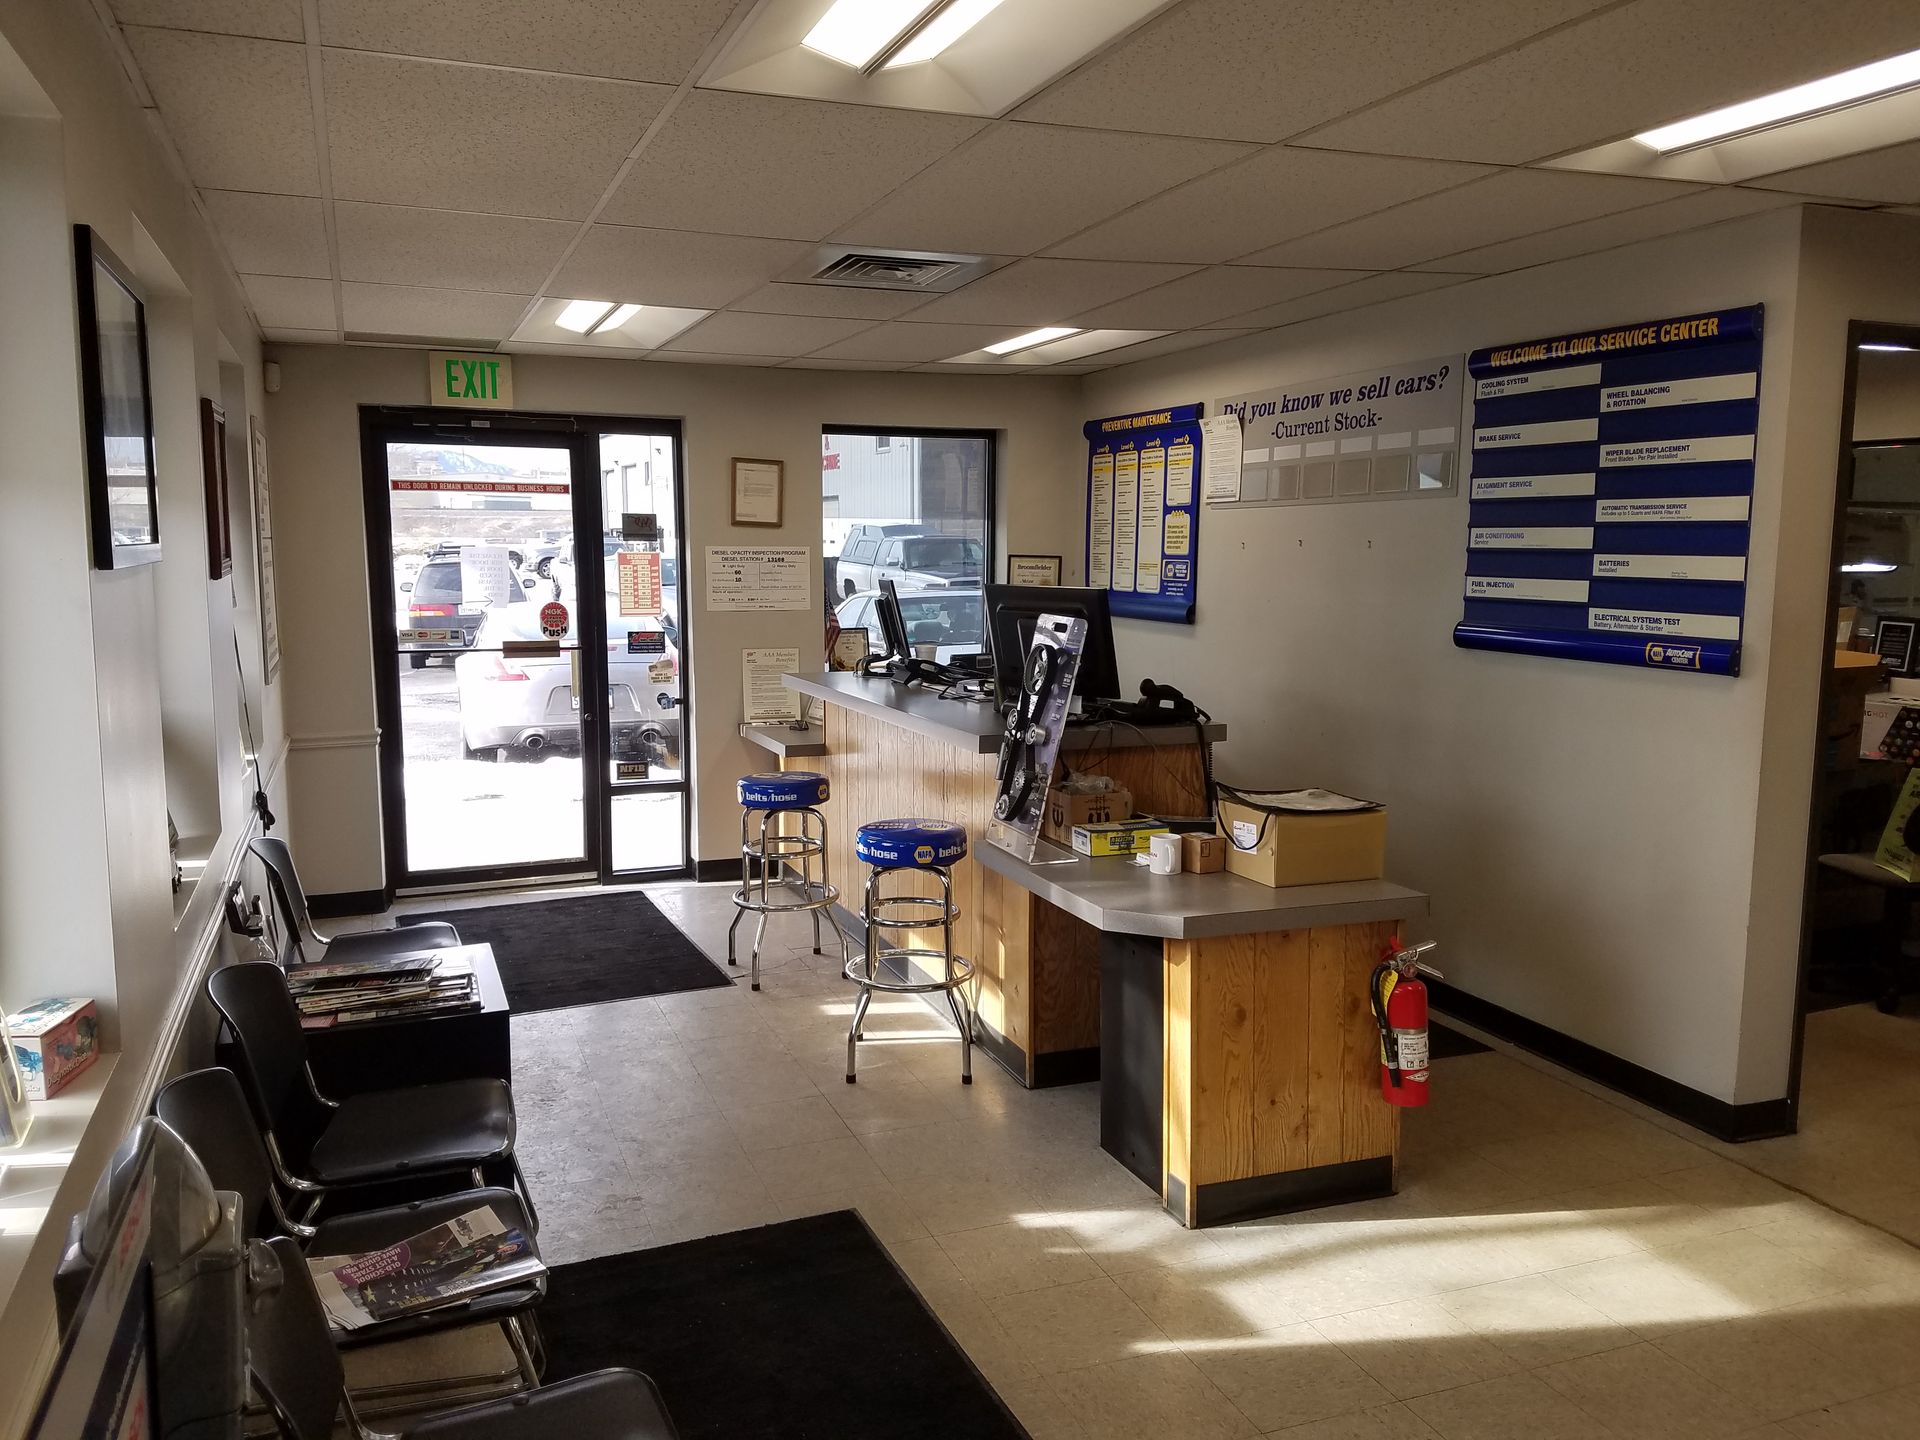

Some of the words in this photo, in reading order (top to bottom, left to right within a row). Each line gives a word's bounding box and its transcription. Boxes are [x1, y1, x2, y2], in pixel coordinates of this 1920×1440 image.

[1490, 344, 1548, 367] WELCOME
[1551, 341, 1566, 358] TO
[1569, 336, 1596, 354] OUR
[1599, 327, 1657, 350] SERVICE
[1660, 317, 1719, 343] CENTER
[445, 359, 500, 399] EXIT
[1481, 379, 1506, 389] COOLING
[1506, 377, 1529, 386] SYSTEM
[1224, 402, 1246, 420] Did
[1249, 401, 1276, 424] you
[1280, 392, 1324, 414] know
[1329, 387, 1352, 405] we
[1357, 375, 1391, 402] sell
[1395, 365, 1450, 396] cars?
[1606, 391, 1629, 399] WHEEL
[1631, 386, 1670, 397] BALANCING
[1613, 398, 1646, 407] ROTATION
[1102, 418, 1132, 433] PREVENTIVE
[1132, 412, 1171, 427] MAINTENANCE
[1498, 433, 1520, 441] SERVICE
[1645, 444, 1690, 454] REPLACEMENT
[413, 482, 428, 490] DOOR
[431, 482, 438, 490] TO
[464, 483, 492, 491] UNLOCKED
[1594, 614, 1631, 622] ELECTRICAL
[1632, 616, 1662, 624] SYSTEMS
[1664, 618, 1680, 626] TEST
[1614, 622, 1638, 630] Alternator
[543, 627, 567, 636] PUSH
[918, 850, 932, 859] NAPA
[381, 1248, 401, 1259] HAVE
[359, 1256, 381, 1269] GIVEN
[376, 1255, 398, 1268] A-LIST
[343, 1266, 358, 1274] WAY
[351, 1266, 374, 1278] STARS
[355, 1261, 401, 1284] OLD-SCHOOL
